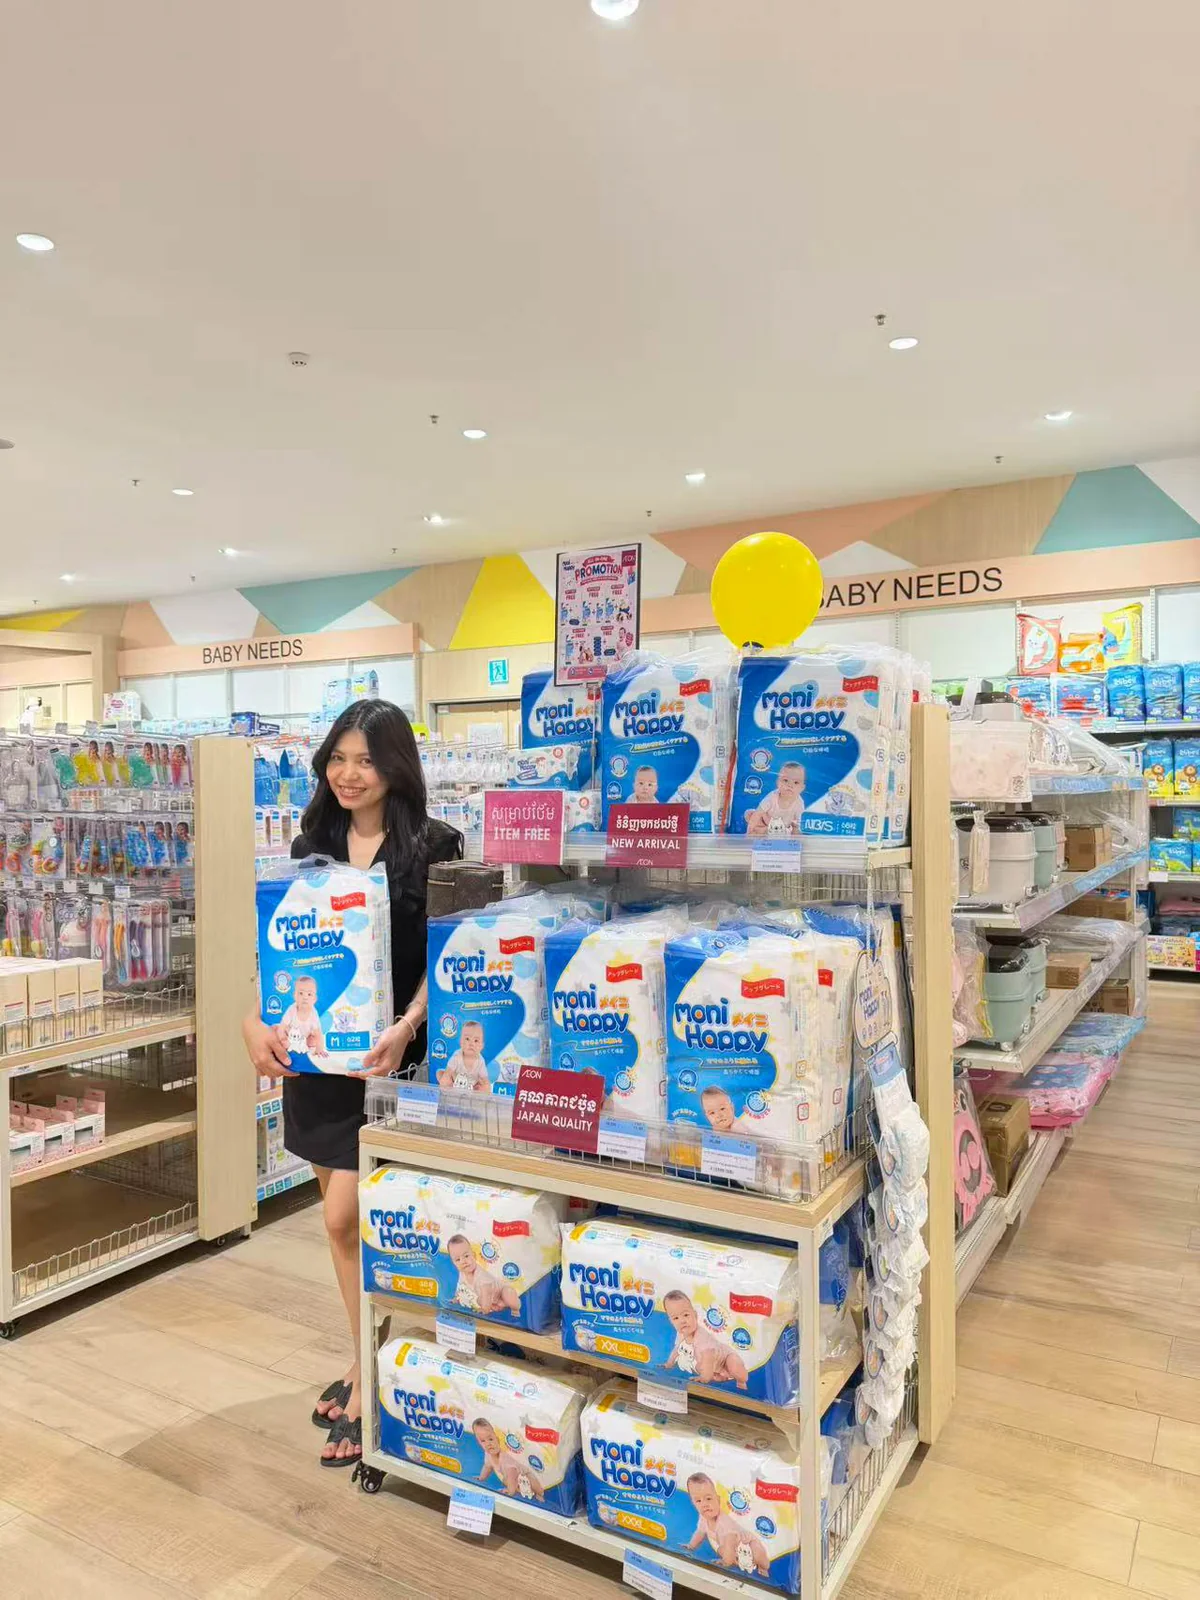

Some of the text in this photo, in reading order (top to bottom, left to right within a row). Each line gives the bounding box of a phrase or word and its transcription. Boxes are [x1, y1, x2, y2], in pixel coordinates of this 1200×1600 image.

[574, 564, 623, 581] PROMOTION
[819, 567, 1003, 609] ABY NEEDS
[203, 639, 303, 664] BABY NEEDS
[543, 717, 597, 738] Happy
[623, 714, 684, 737] Happy
[770, 709, 846, 730] Happy
[493, 828, 550, 841] ITEM FREE
[805, 818, 834, 832] NB/S
[611, 838, 680, 850] NEW ARRIVAL
[284, 930, 345, 951] Happy
[452, 974, 513, 994] Happy
[563, 1011, 630, 1033] Happy
[330, 1036, 340, 1047] M
[685, 1025, 769, 1053] Happy
[498, 1086, 506, 1095] M
[516, 1110, 593, 1132] JAPAN QUALITY
[379, 1228, 440, 1256] Happy
[396, 1278, 412, 1291] XL
[580, 1284, 655, 1318] Happy
[601, 1338, 624, 1354] XXL
[404, 1407, 465, 1439] Happy
[601, 1460, 676, 1497] Happy
